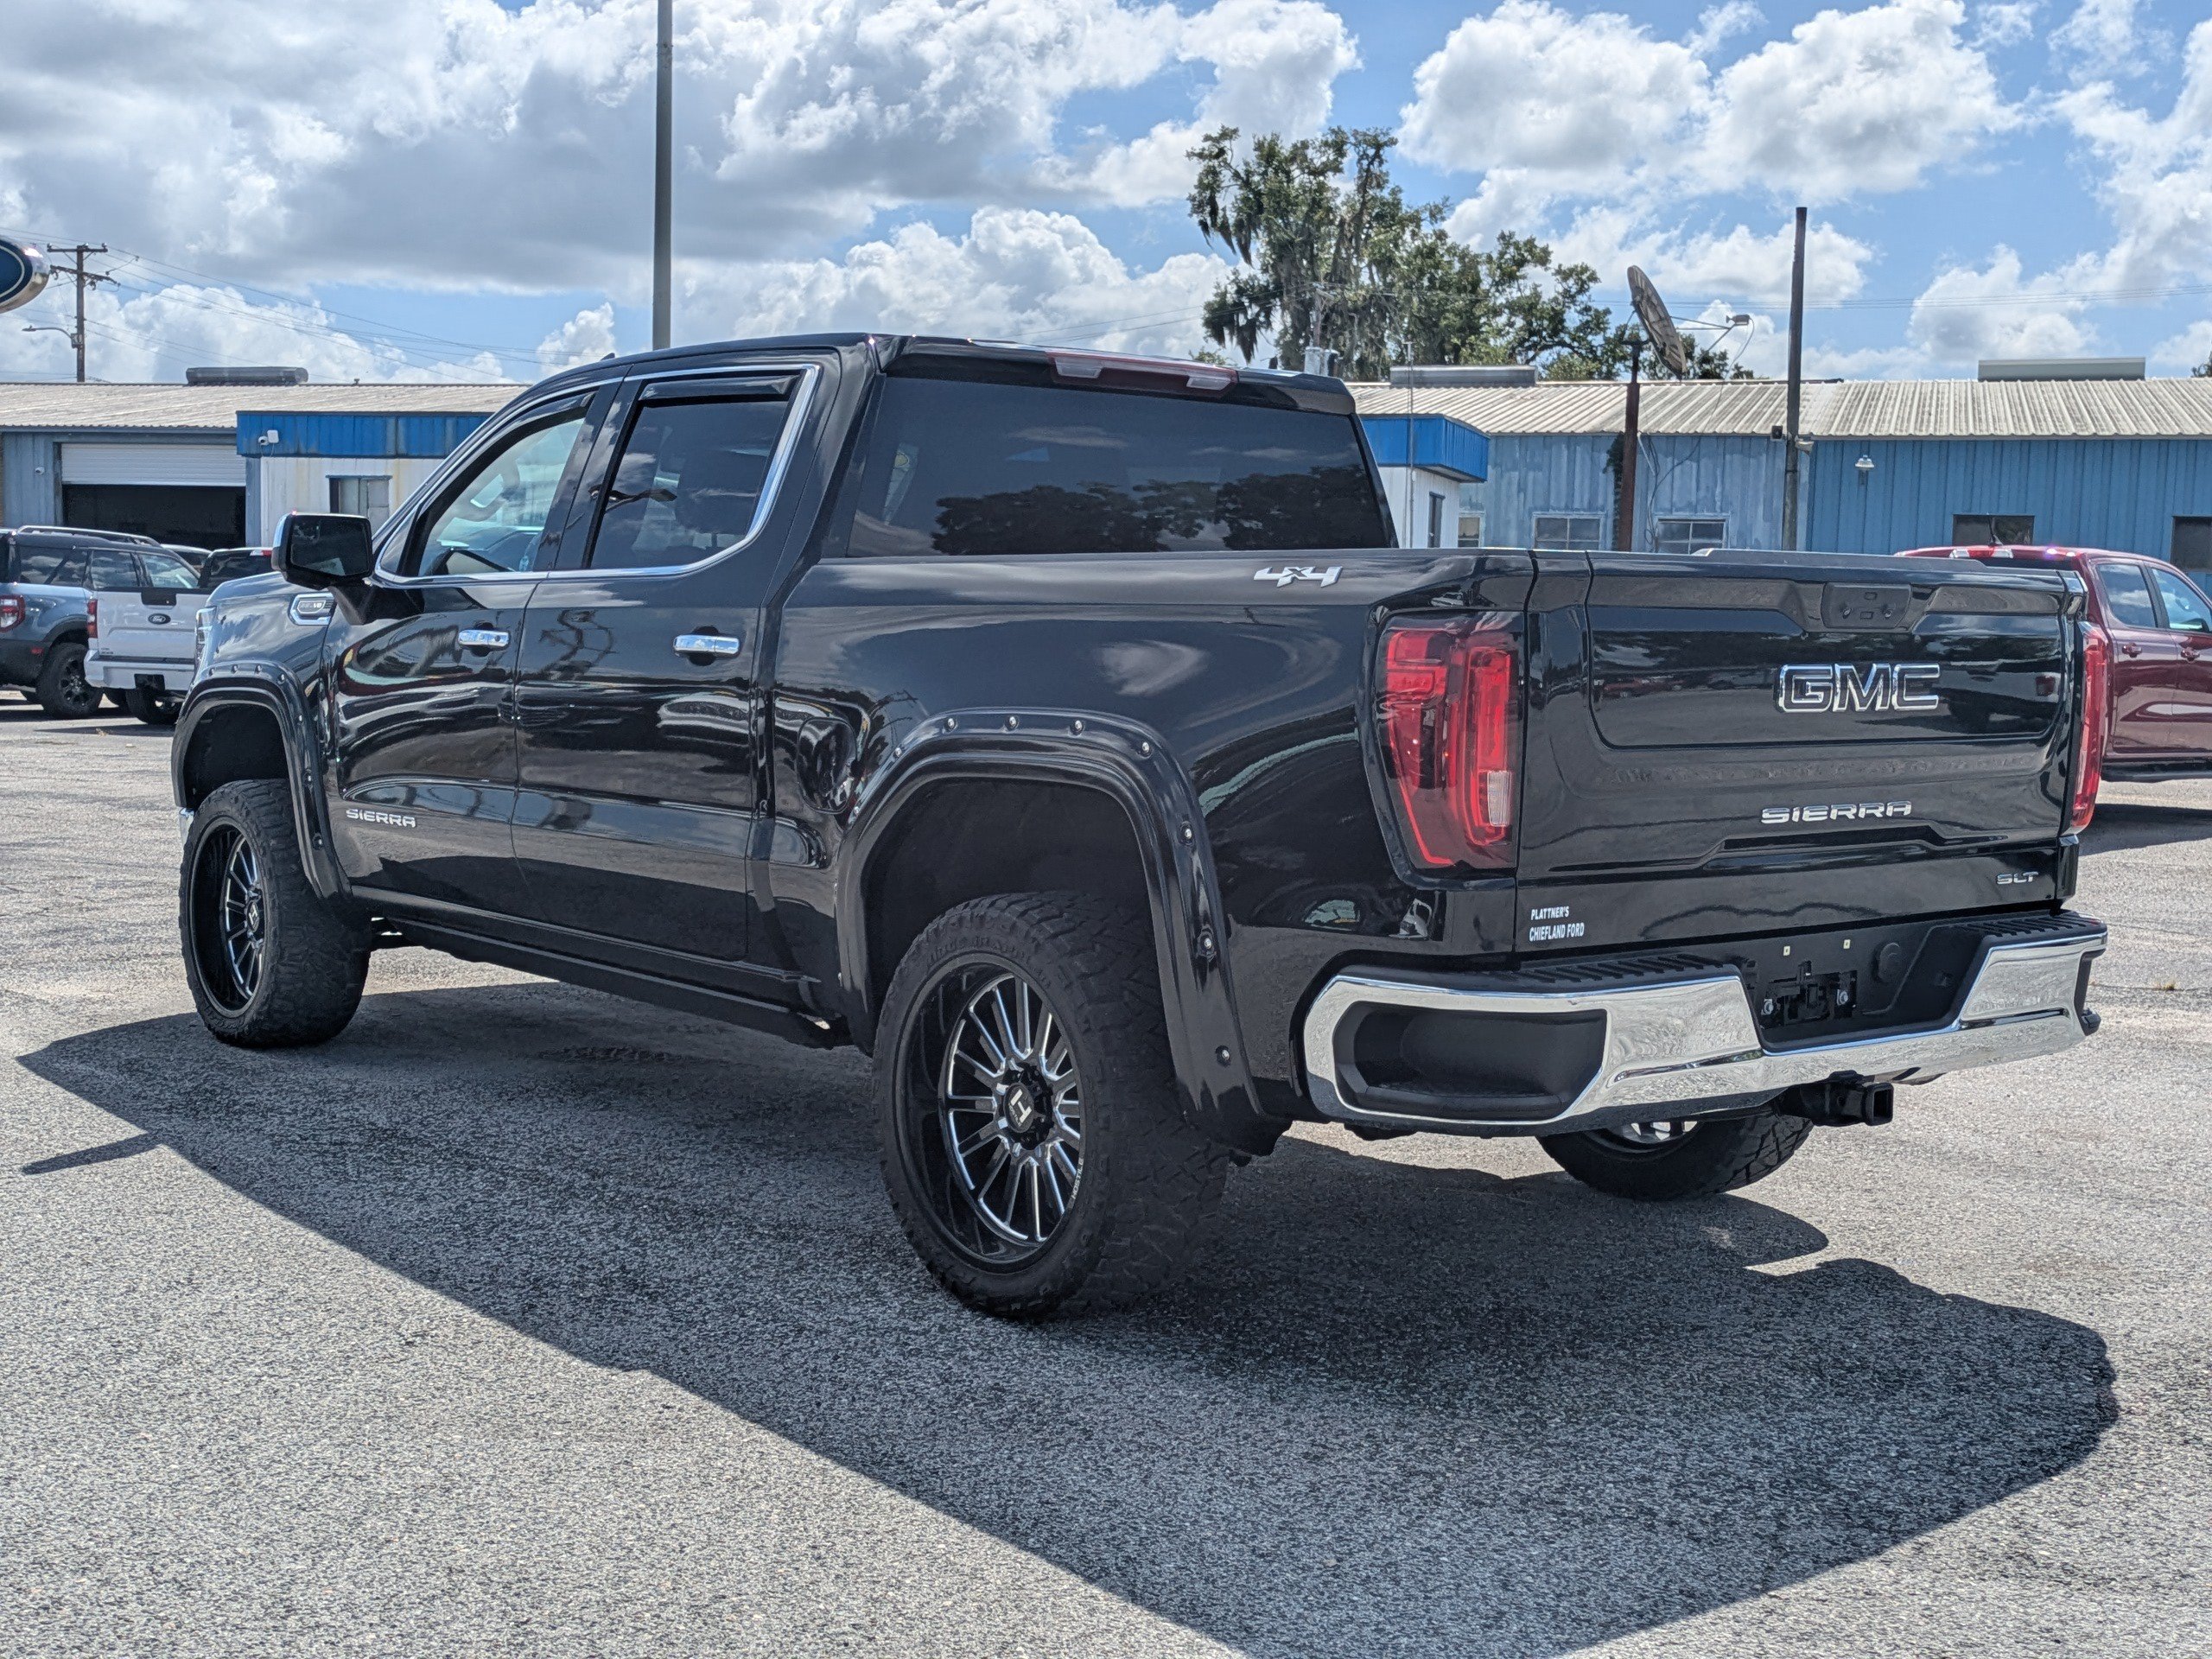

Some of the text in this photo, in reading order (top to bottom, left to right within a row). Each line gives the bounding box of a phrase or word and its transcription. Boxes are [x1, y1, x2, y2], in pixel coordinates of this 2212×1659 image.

[1777, 663, 1941, 713] GMC
[346, 808, 416, 828] SIERRA
[1760, 800, 1912, 824] SIERRA
[1997, 871, 2039, 885] SLT
[1530, 906, 1570, 921] PLATTNER'S
[1529, 922, 1585, 942] CHIEFLAND FORD
[1071, 1157, 1085, 1199] HOSTILE
